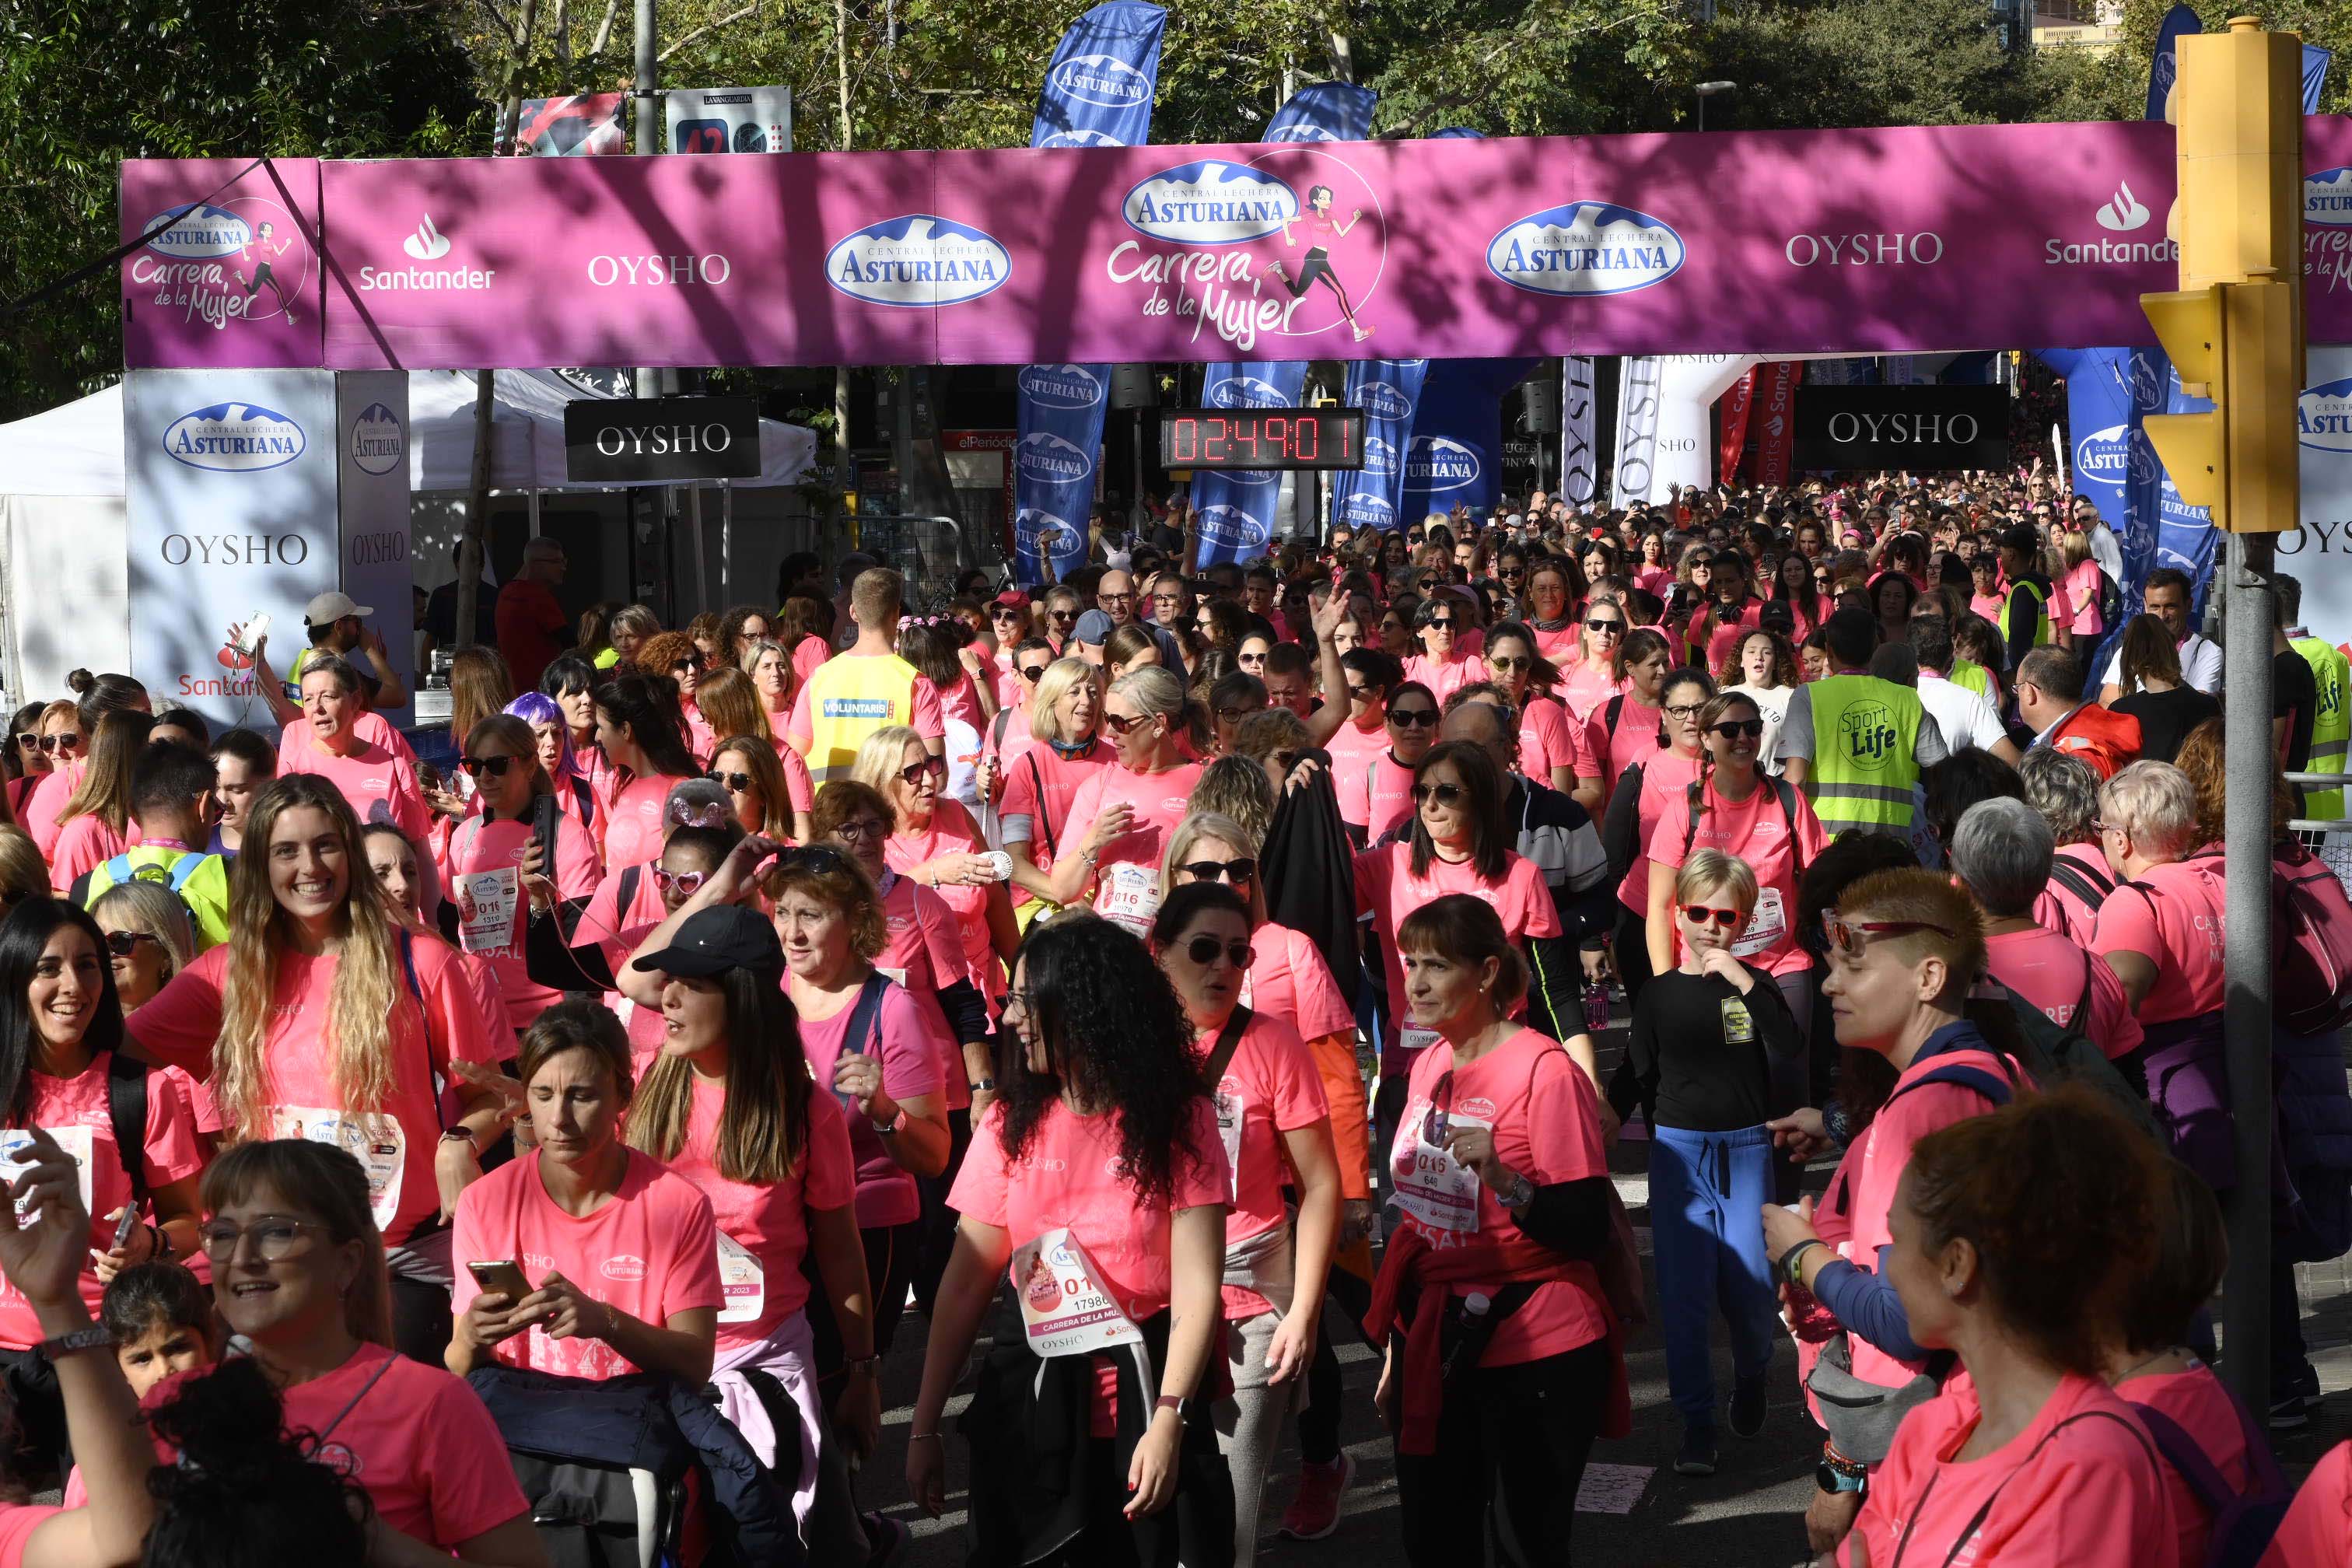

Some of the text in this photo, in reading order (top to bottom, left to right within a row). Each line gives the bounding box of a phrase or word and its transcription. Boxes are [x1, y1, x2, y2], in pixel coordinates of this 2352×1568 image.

[1059, 67, 1143, 99] ASTURIANA
[1136, 191, 1284, 223] ASTURIANA
[1163, 187, 1280, 198] CENTRAL LECHERA
[867, 246, 990, 256] CENTRAL LECHERA
[1532, 233, 1663, 244] CENTRAL LECHERA
[1786, 232, 1944, 266] OYSHO
[838, 249, 997, 283] ASTURIANA
[1107, 240, 1253, 285] Carrera
[1502, 237, 1670, 272] ASTURIANA
[131, 254, 223, 285] Carrera
[359, 266, 495, 290] Santander
[587, 254, 731, 286] OYSHO
[155, 281, 257, 330] de la Mujer
[1143, 278, 1307, 351] de la Mujer
[173, 428, 296, 455] ASTURIANA
[195, 425, 291, 435] CENTRAL LECHERA
[597, 423, 731, 456] OYSHO
[1828, 411, 1979, 444] OYSHO
[355, 430, 401, 458] ASTURIANA
[1659, 438, 1696, 453] SHO
[161, 534, 309, 566] OYSHO
[352, 530, 404, 567] OYSHO
[824, 702, 886, 714] VOLUNTARIS
[1843, 706, 1888, 733] Sport
[1851, 724, 1896, 759] Life
[1374, 791, 1402, 800] OYSHO
[1115, 892, 1139, 905] 016
[1409, 1034, 1439, 1042] OYSHO
[1418, 1154, 1447, 1174] 016
[1043, 1318, 1080, 1332] CARRERA
[1080, 1314, 1092, 1324] DE
[1092, 1312, 1103, 1321] LA
